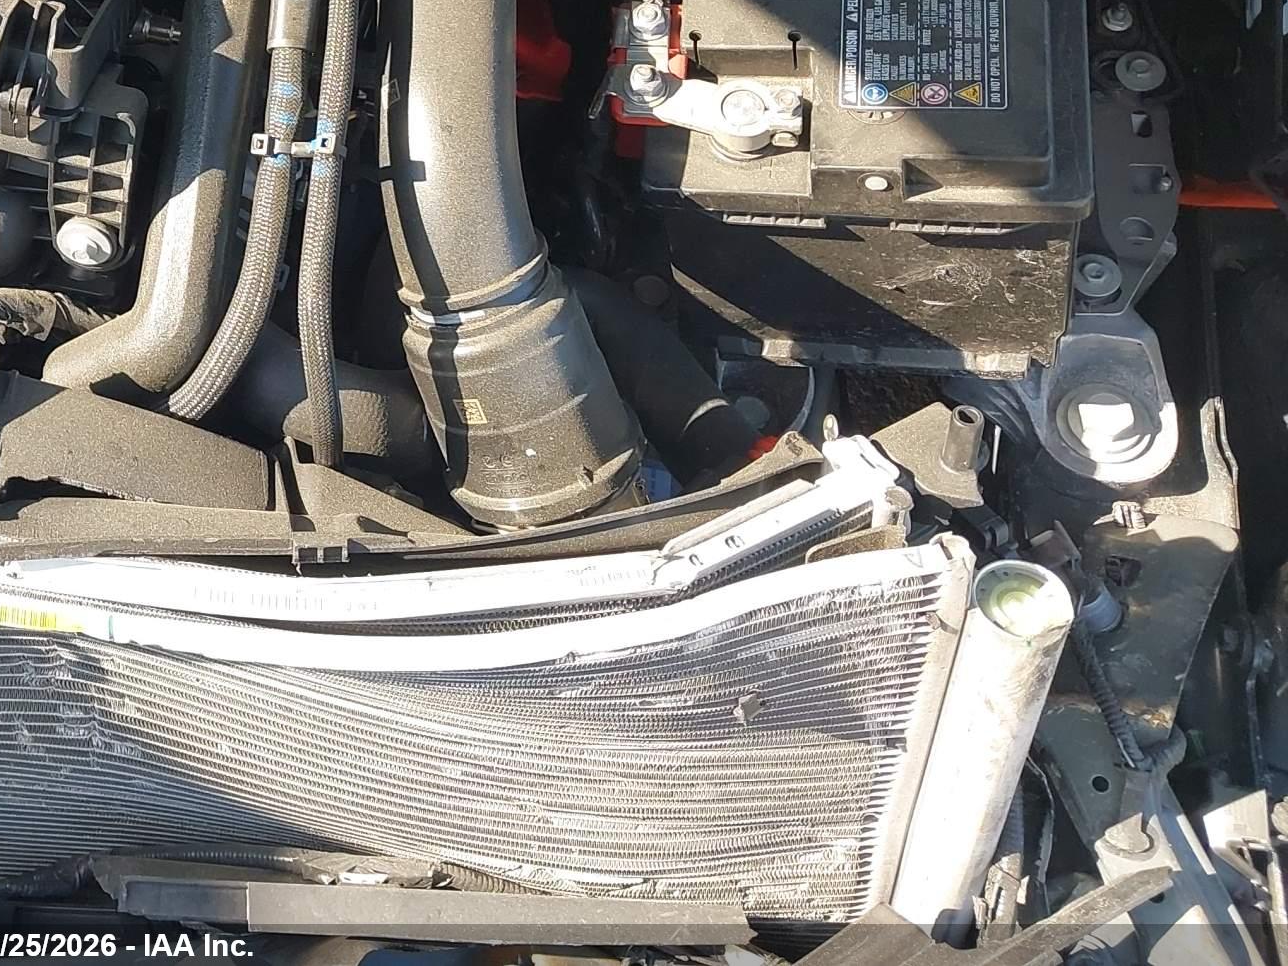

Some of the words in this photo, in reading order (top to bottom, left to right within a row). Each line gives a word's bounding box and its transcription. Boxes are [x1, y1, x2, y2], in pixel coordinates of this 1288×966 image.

[990, 0, 1000, 28] OUVRIR.
[990, 28, 1000, 42] PAS
[990, 42, 1000, 53] NE
[844, 29, 859, 92] DANGER/POISON
[991, 56, 1001, 76] OPEN.
[991, 78, 1001, 92] NOT
[991, 92, 1001, 103] DO
